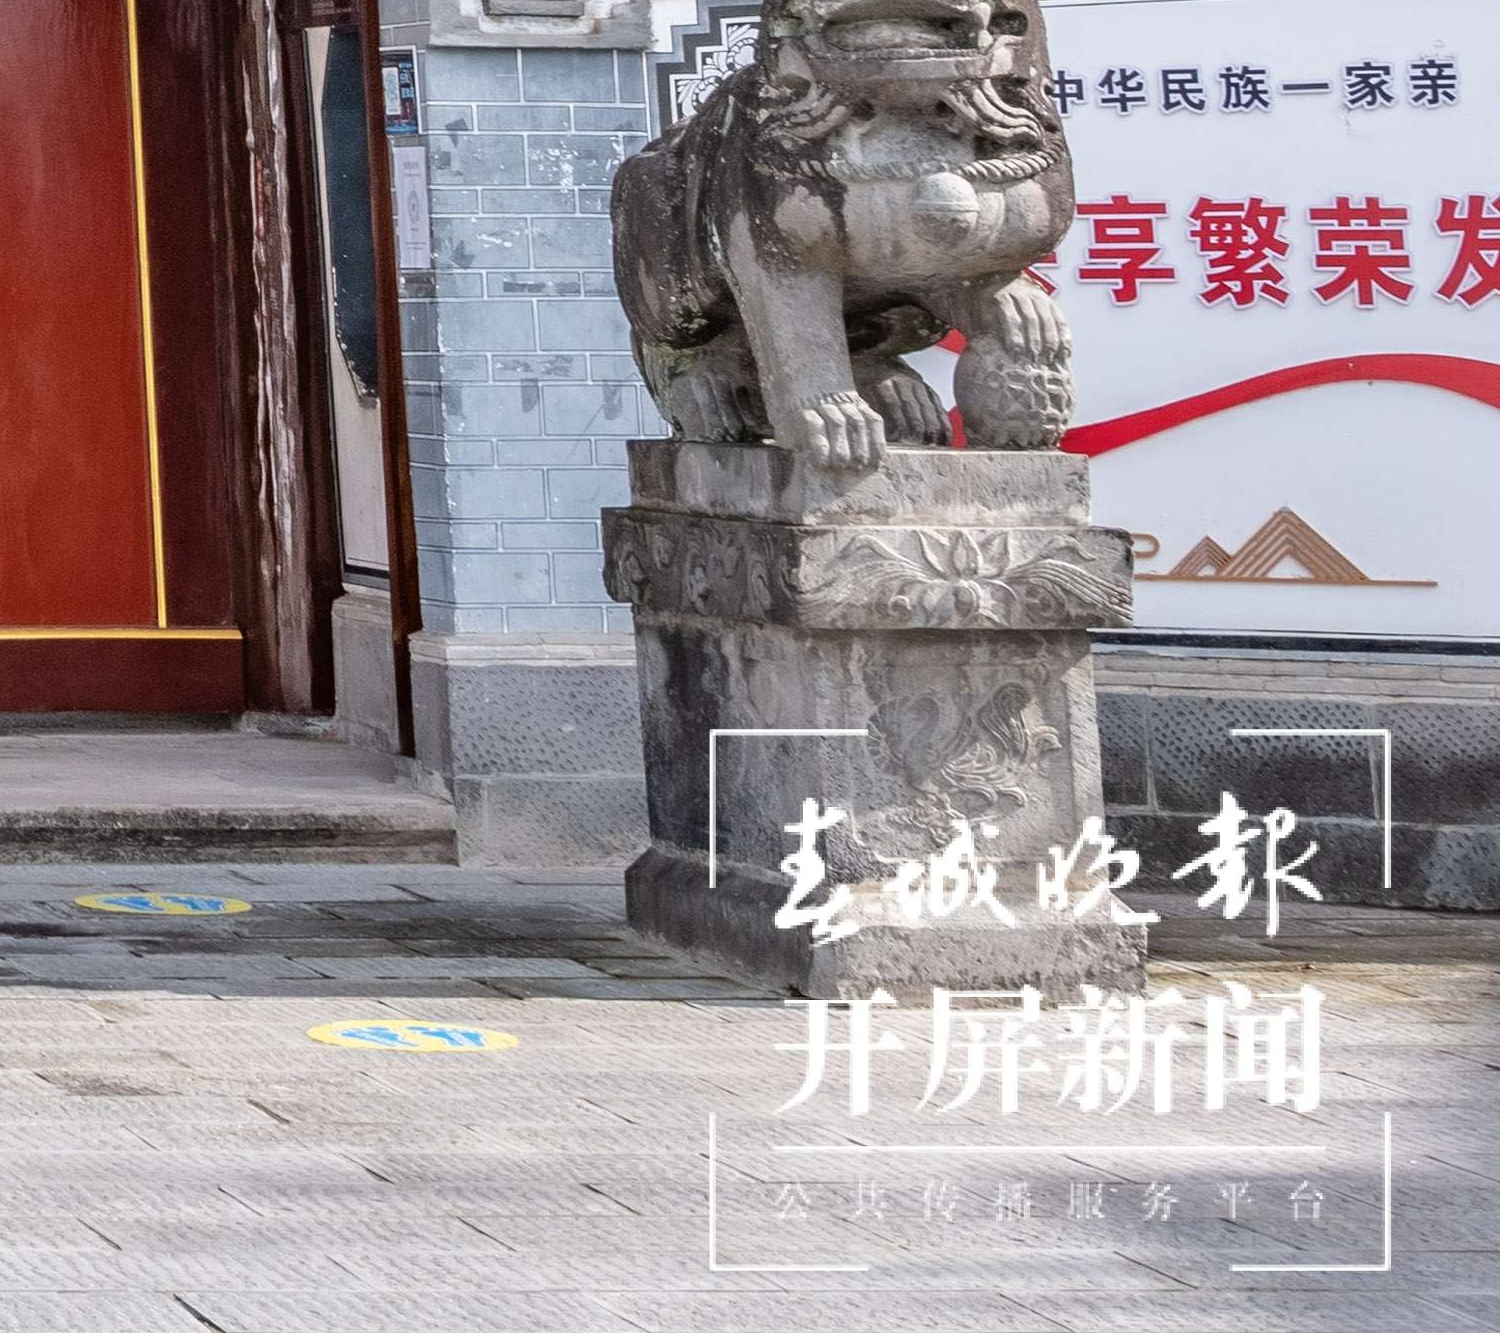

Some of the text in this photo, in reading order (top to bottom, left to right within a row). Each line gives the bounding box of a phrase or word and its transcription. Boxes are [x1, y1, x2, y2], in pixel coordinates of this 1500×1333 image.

[1051, 58, 1458, 115] 中华民族一家亲
[1024, 194, 1500, 306] 享繁荣发
